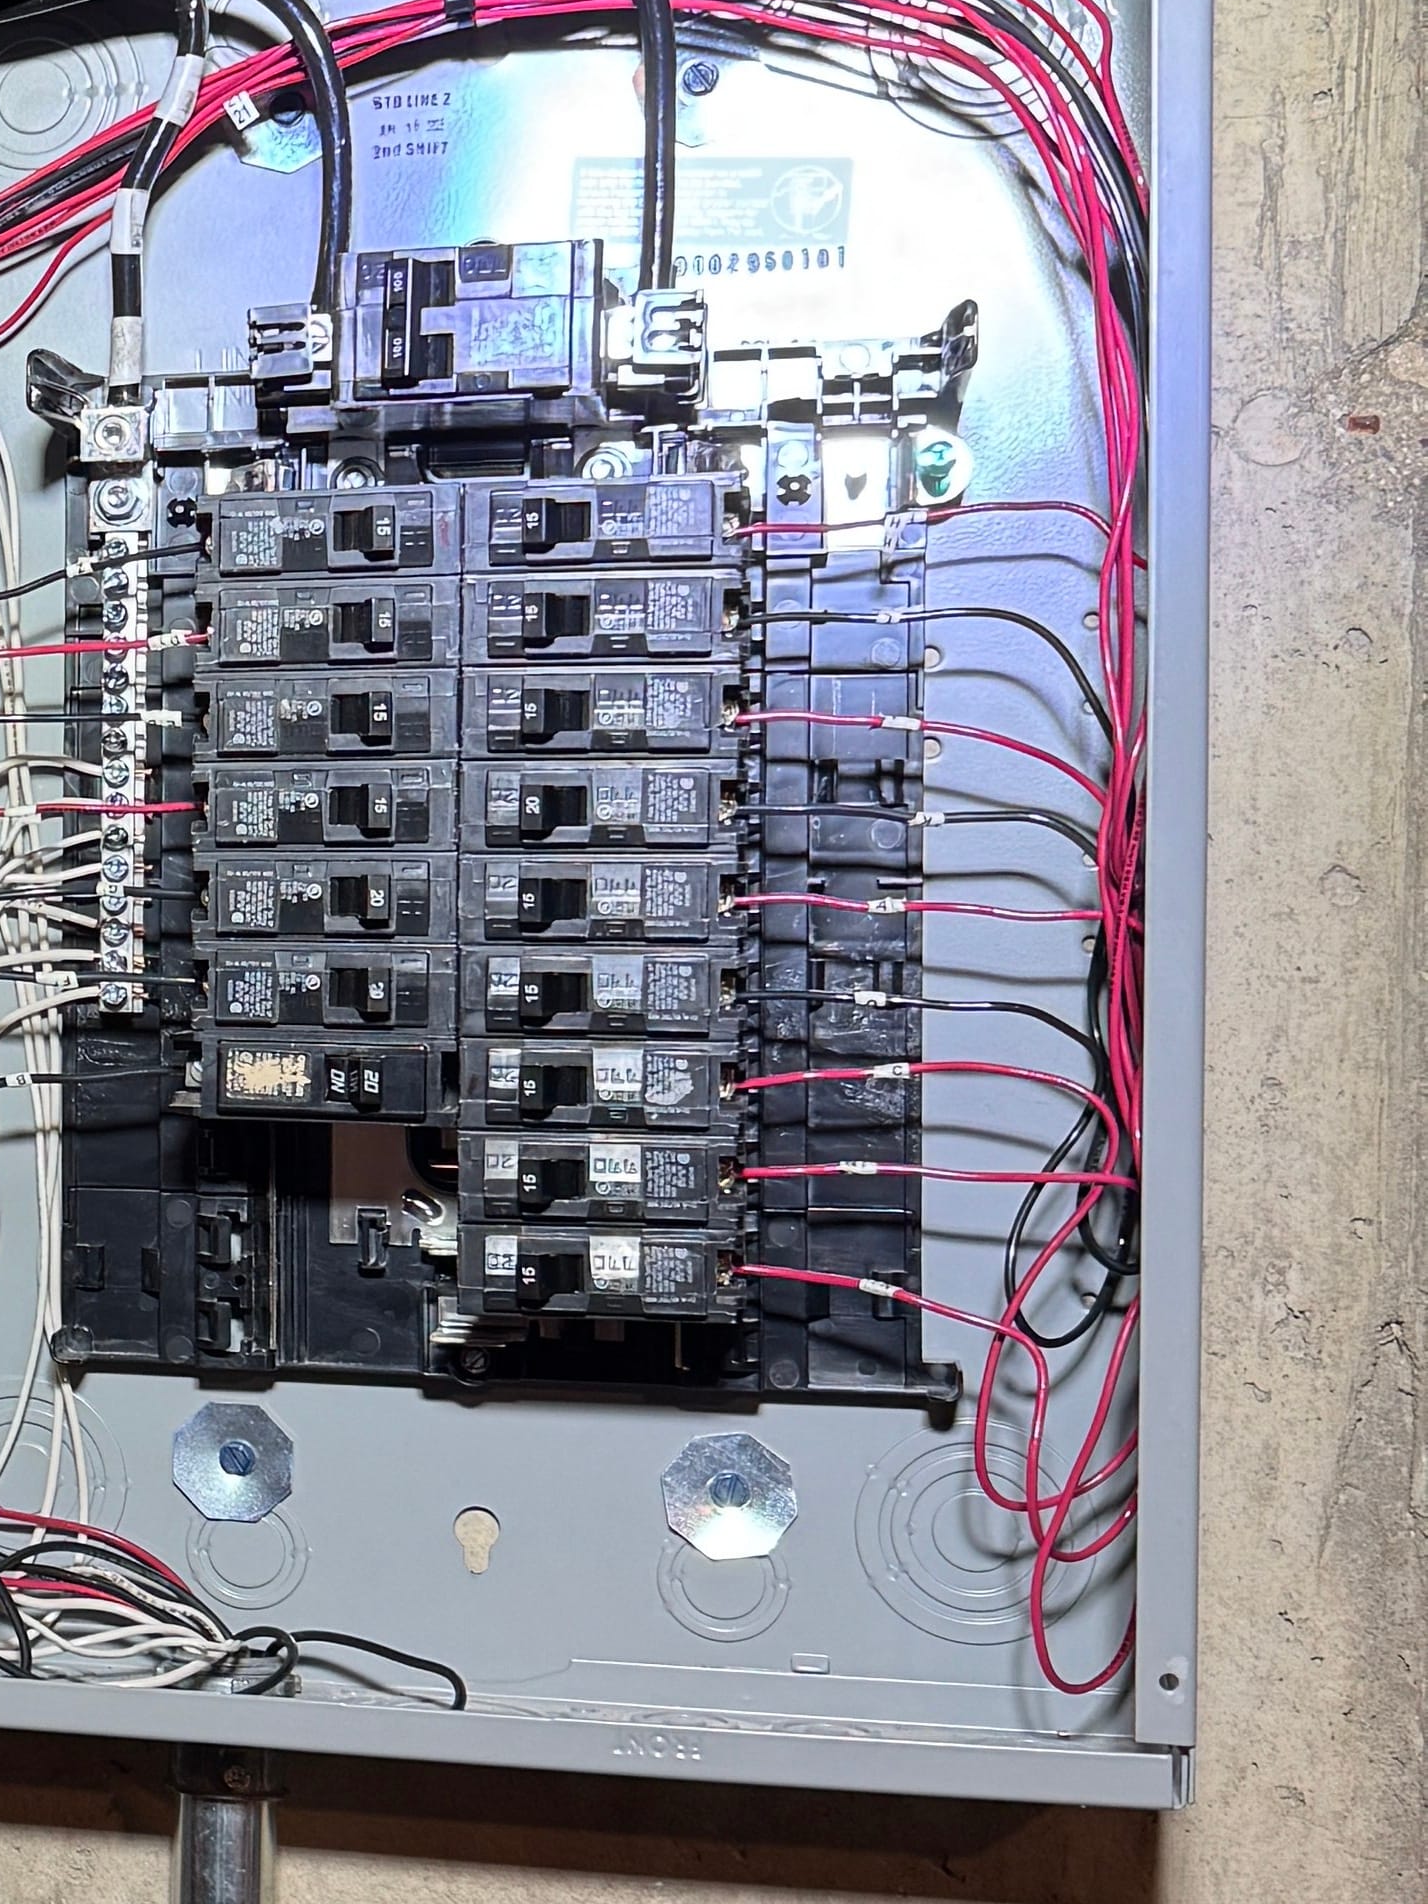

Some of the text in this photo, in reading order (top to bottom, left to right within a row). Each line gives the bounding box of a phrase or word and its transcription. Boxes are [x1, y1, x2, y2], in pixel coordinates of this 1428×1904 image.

[233, 104, 251, 124] 21
[406, 141, 449, 156] SHIFT
[393, 271, 404, 292] 100
[392, 337, 403, 358] 100
[376, 517, 391, 537] 15
[525, 511, 539, 529] 15
[378, 610, 392, 629] 15
[524, 604, 539, 623] 15
[373, 702, 388, 722] 15
[524, 702, 538, 720] 15
[374, 797, 388, 816] 15
[525, 796, 541, 815] 20
[369, 889, 385, 908] 20
[522, 892, 536, 910] 15
[524, 984, 539, 1003] 15
[329, 1068, 346, 1094] ON
[363, 1068, 379, 1094] 20
[523, 1079, 537, 1097] 15
[522, 1174, 537, 1193] 15
[521, 1266, 536, 1285] 15
